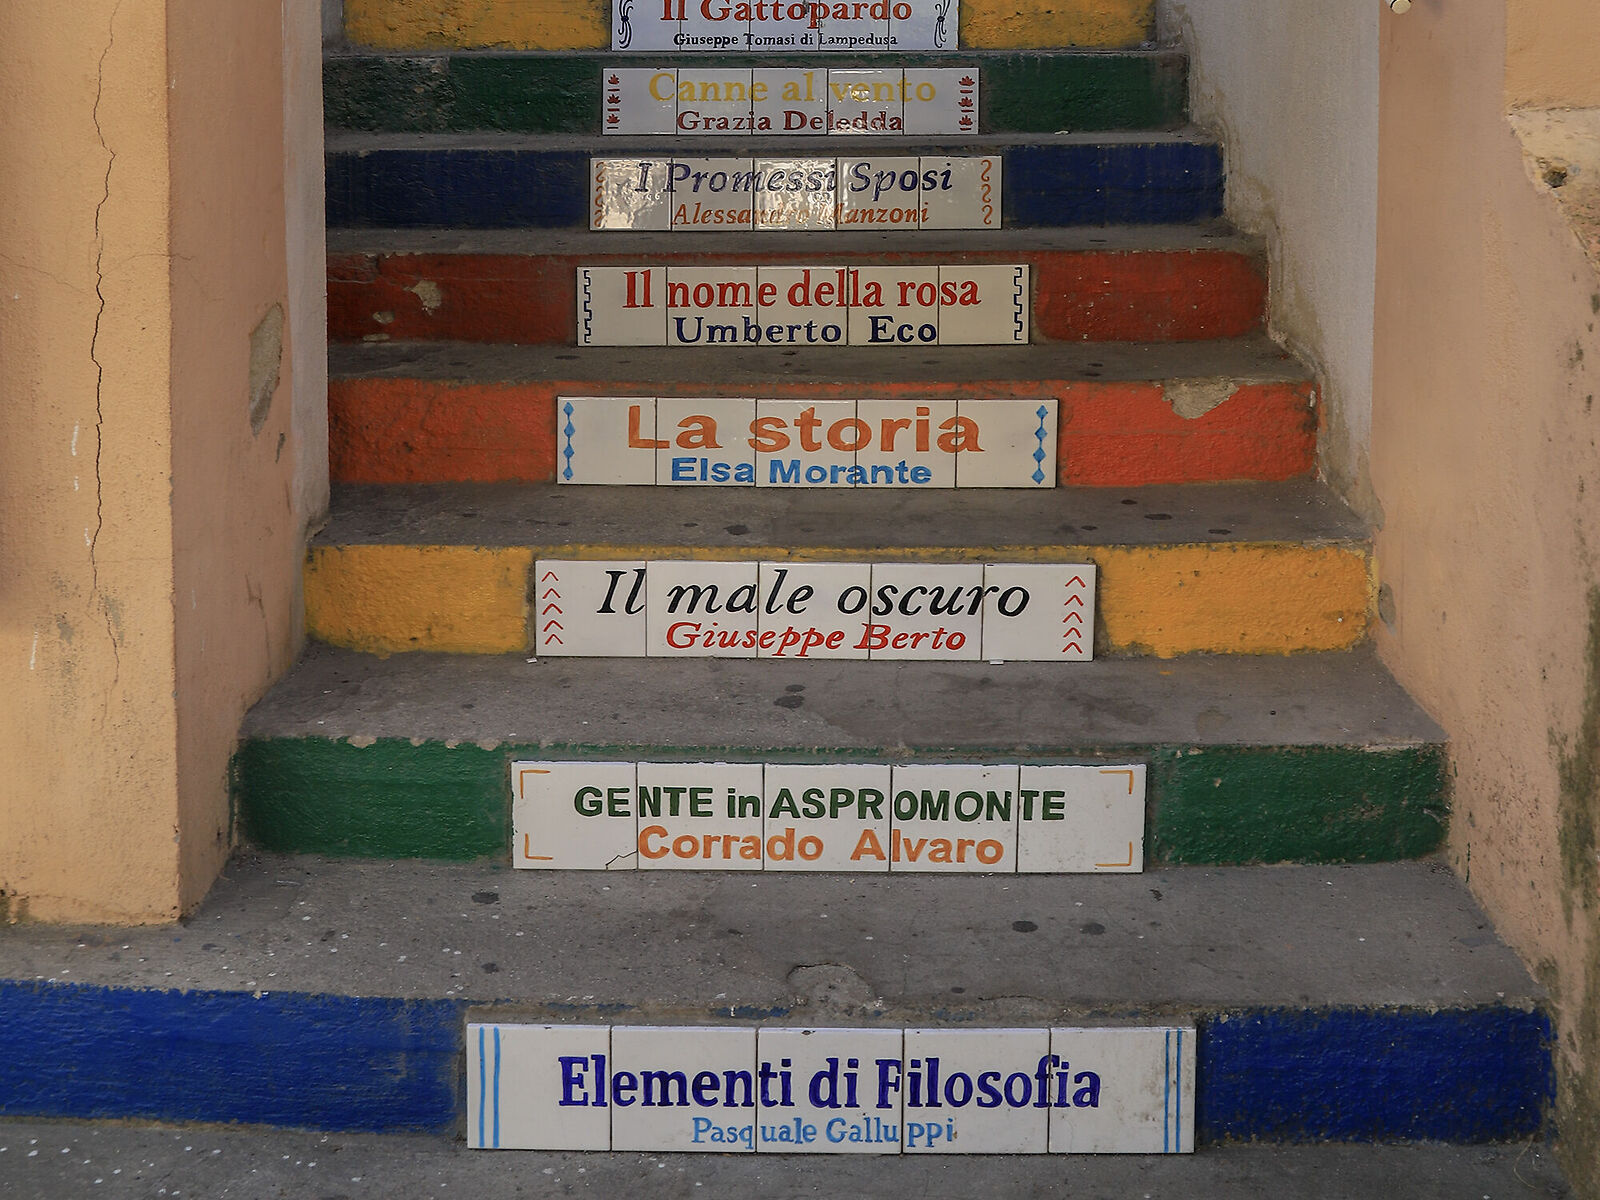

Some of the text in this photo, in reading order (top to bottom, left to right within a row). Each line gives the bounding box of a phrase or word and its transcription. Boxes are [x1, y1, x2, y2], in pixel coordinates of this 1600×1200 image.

[673, 31, 899, 49] Giuseppe Tomasi di Lampedusa
[649, 71, 937, 102] Canne al vento
[676, 109, 904, 133] Grazia Deledda
[634, 161, 953, 202] I Promessi Sposi
[622, 267, 982, 308] Il nome della rosa
[672, 314, 938, 345] Umberto Eco
[627, 404, 986, 454] La storia
[671, 456, 933, 486] Elsa Morante
[596, 567, 1031, 618] Il male oscuro
[664, 620, 968, 658] Giuseppe Berto
[573, 784, 1067, 823] GENTE in ASPROMONTE
[637, 824, 1005, 866] Corrado Alvaro
[557, 1052, 1103, 1110] Elementi di Filosofia
[691, 1115, 956, 1153] Pasquale Galluppi
